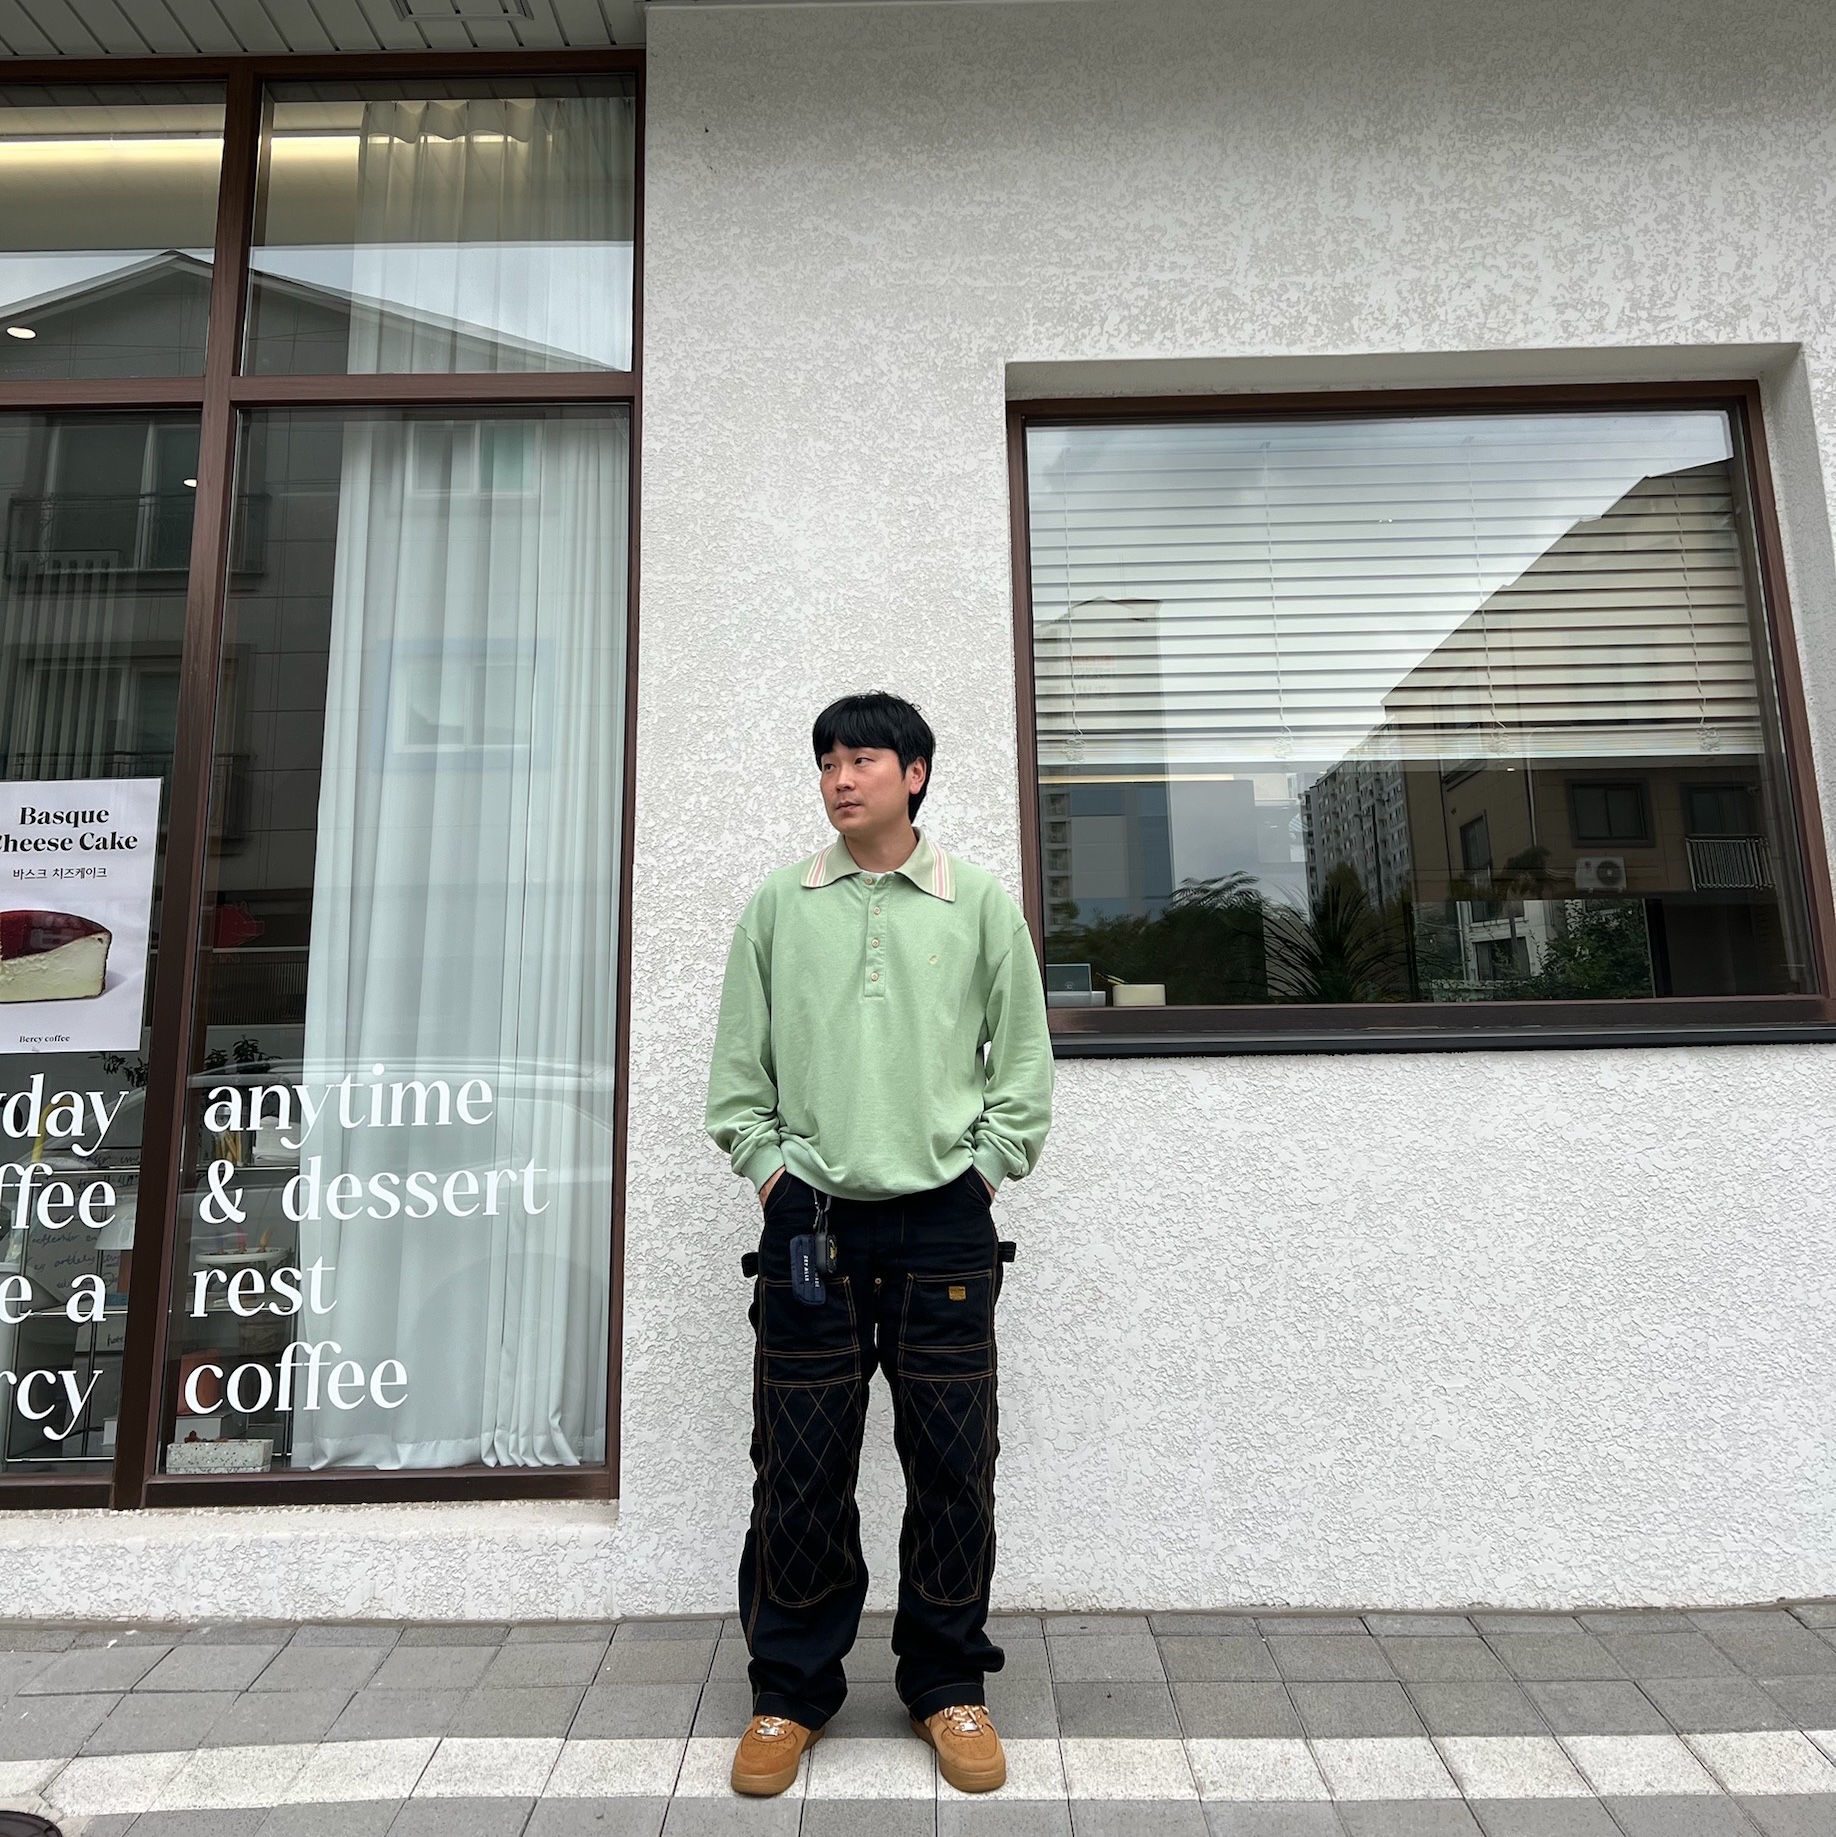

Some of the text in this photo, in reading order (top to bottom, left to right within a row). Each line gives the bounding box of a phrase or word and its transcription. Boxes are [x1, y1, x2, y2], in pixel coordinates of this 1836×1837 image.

[19, 806, 110, 828] Basque
[0, 831, 138, 853] heese Cake
[13, 867, 108, 880] 바스크 치즈케이크
[19, 1034, 71, 1044] Bercy coffee
[0, 1063, 494, 1157] day anytime
[199, 1159, 247, 1224] &
[281, 1156, 550, 1221] dessert
[66, 1274, 107, 1323] a
[190, 1256, 337, 1318] rest
[184, 1341, 409, 1415] coffee
